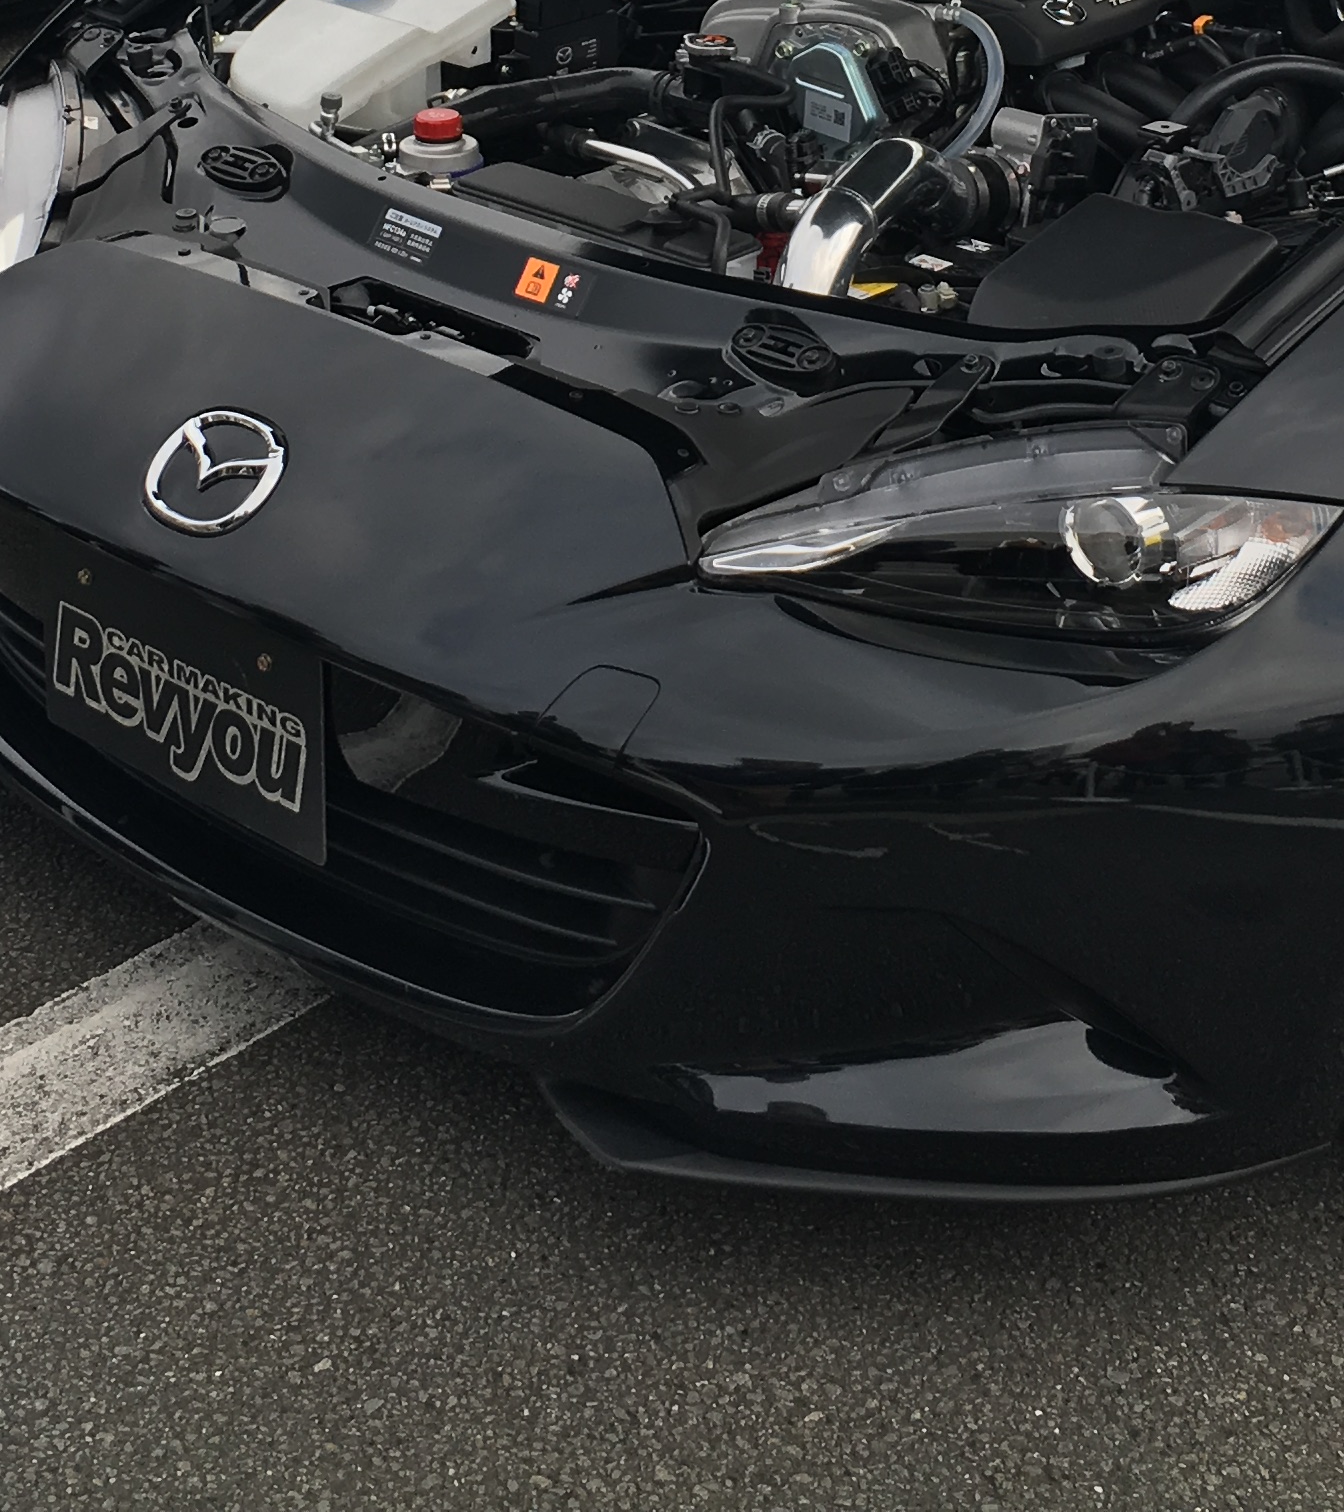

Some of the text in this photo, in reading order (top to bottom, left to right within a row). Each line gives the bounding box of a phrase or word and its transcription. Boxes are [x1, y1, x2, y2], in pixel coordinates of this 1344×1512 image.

[54, 600, 306, 812] Revyou
[104, 628, 305, 740] CAR MAKING
